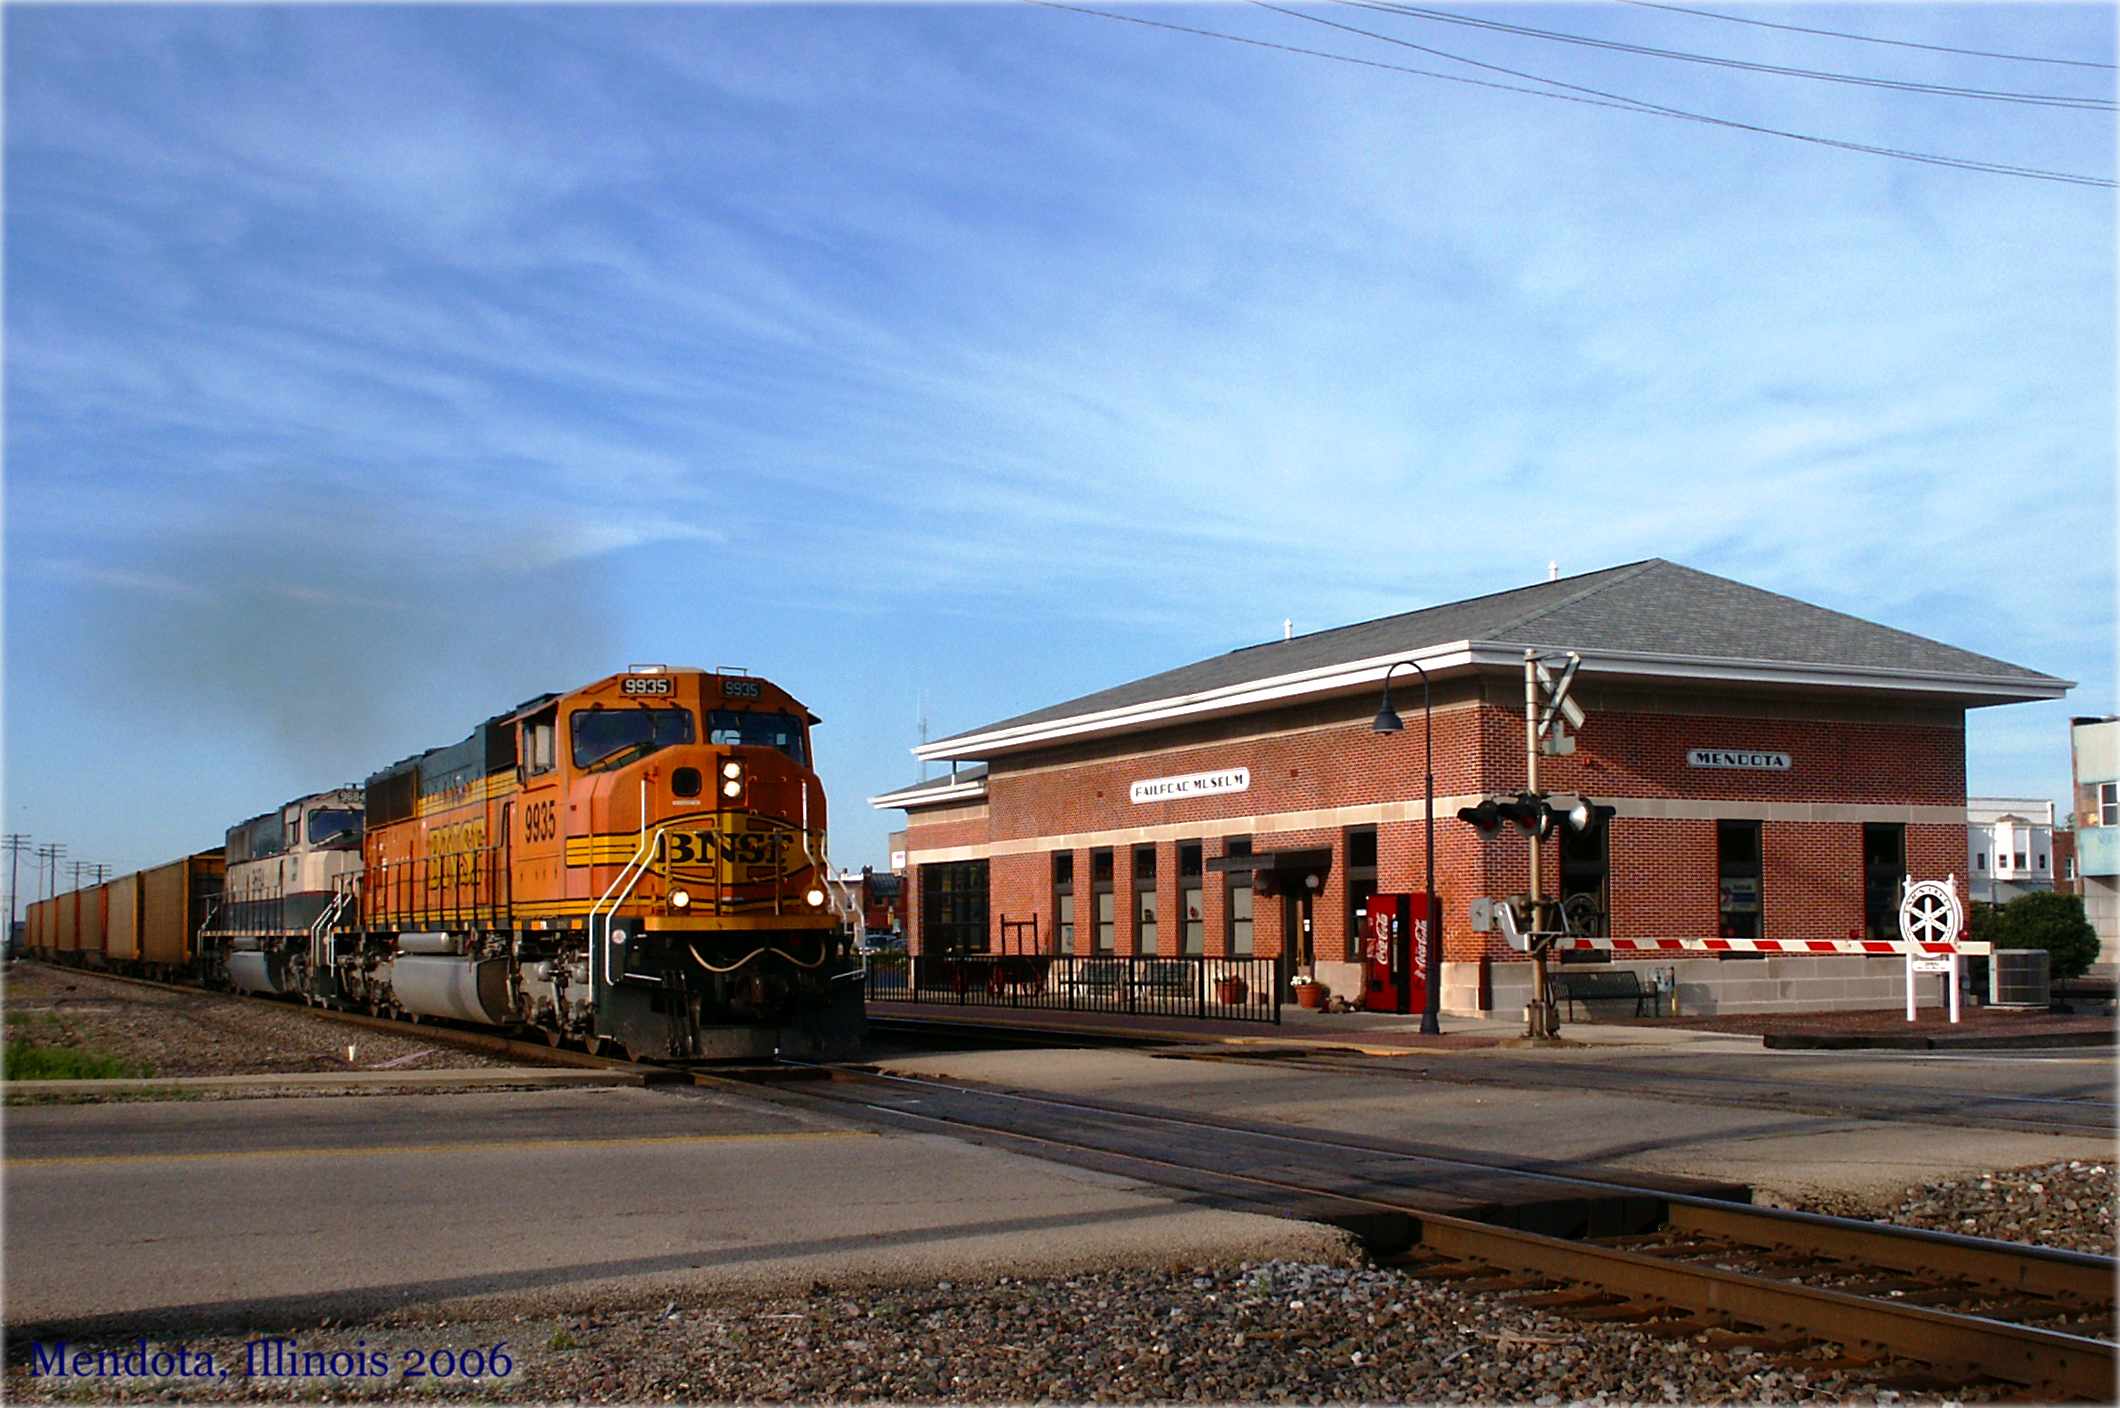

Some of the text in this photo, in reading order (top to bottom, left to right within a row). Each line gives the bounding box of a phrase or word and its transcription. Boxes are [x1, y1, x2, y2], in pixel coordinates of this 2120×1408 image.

[625, 678, 668, 694] 9935
[725, 681, 759, 697] 9935
[1696, 752, 1784, 766] MENDOTA
[1193, 774, 1243, 790] MUSEUM
[525, 799, 556, 844] 9935
[656, 831, 794, 864] BNSF
